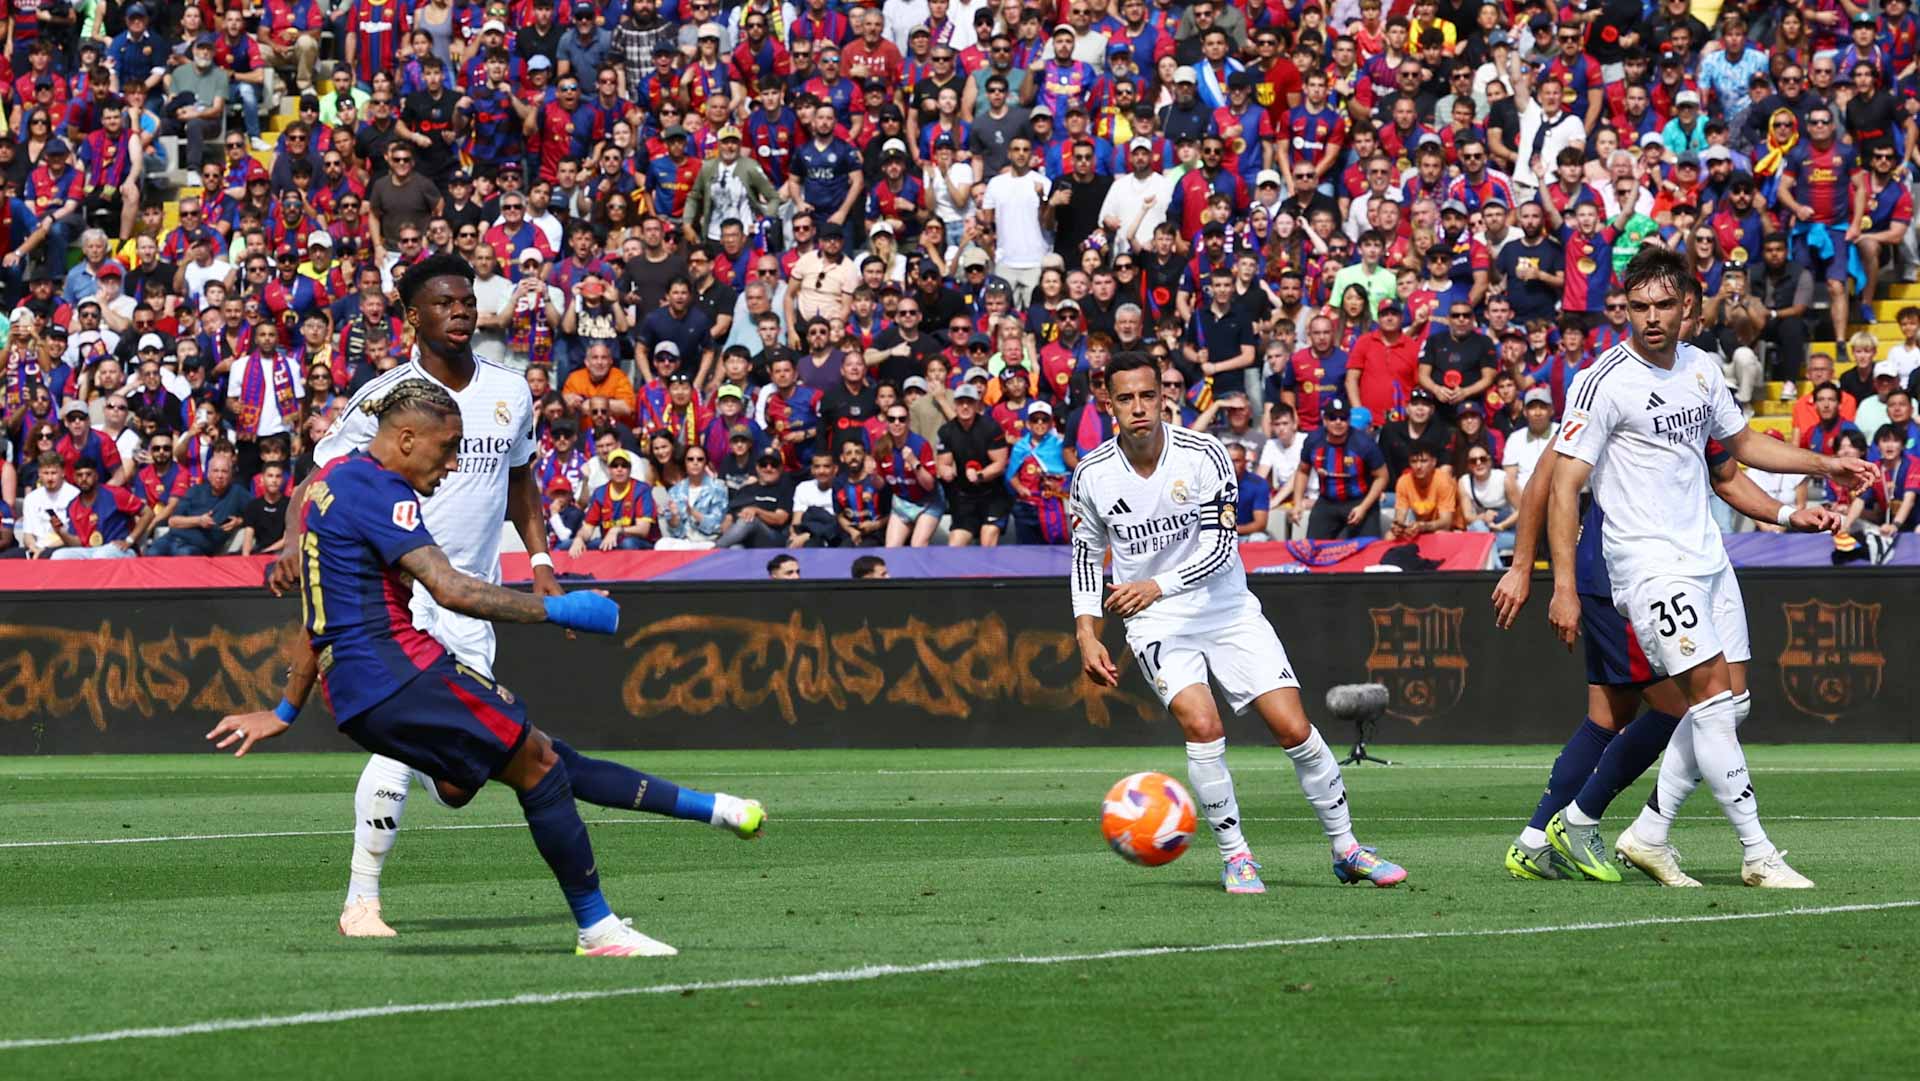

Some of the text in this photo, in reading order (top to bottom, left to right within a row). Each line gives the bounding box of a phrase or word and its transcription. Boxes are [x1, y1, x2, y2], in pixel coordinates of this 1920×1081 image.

[1112, 508, 1200, 541] Emirates
[1130, 527, 1190, 556] FLY BETTER
[1650, 592, 1698, 637] 35
[1139, 640, 1162, 681] 17
